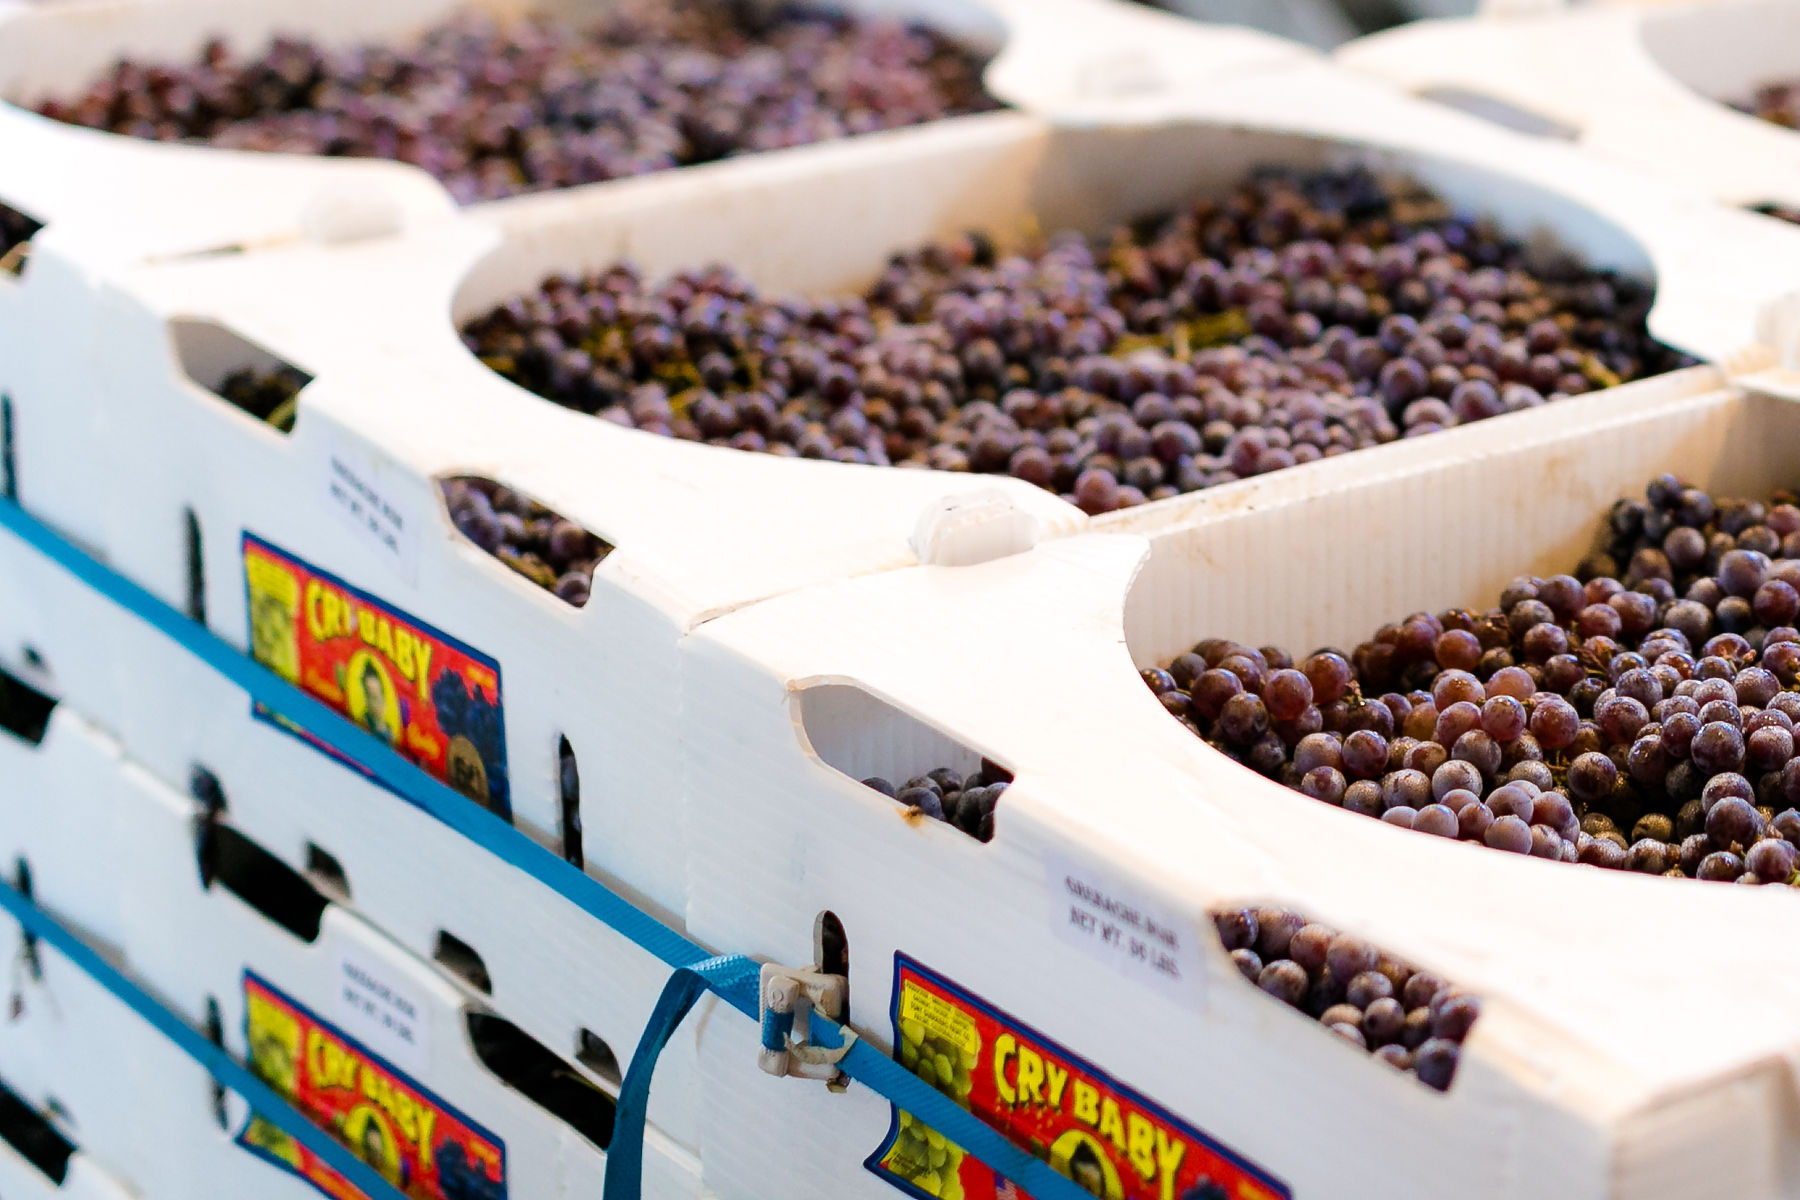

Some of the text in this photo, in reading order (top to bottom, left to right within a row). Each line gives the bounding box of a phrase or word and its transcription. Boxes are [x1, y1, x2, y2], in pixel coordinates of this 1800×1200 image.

[357, 608, 433, 704] BABY
[993, 1032, 1187, 1200] CRY BABY
